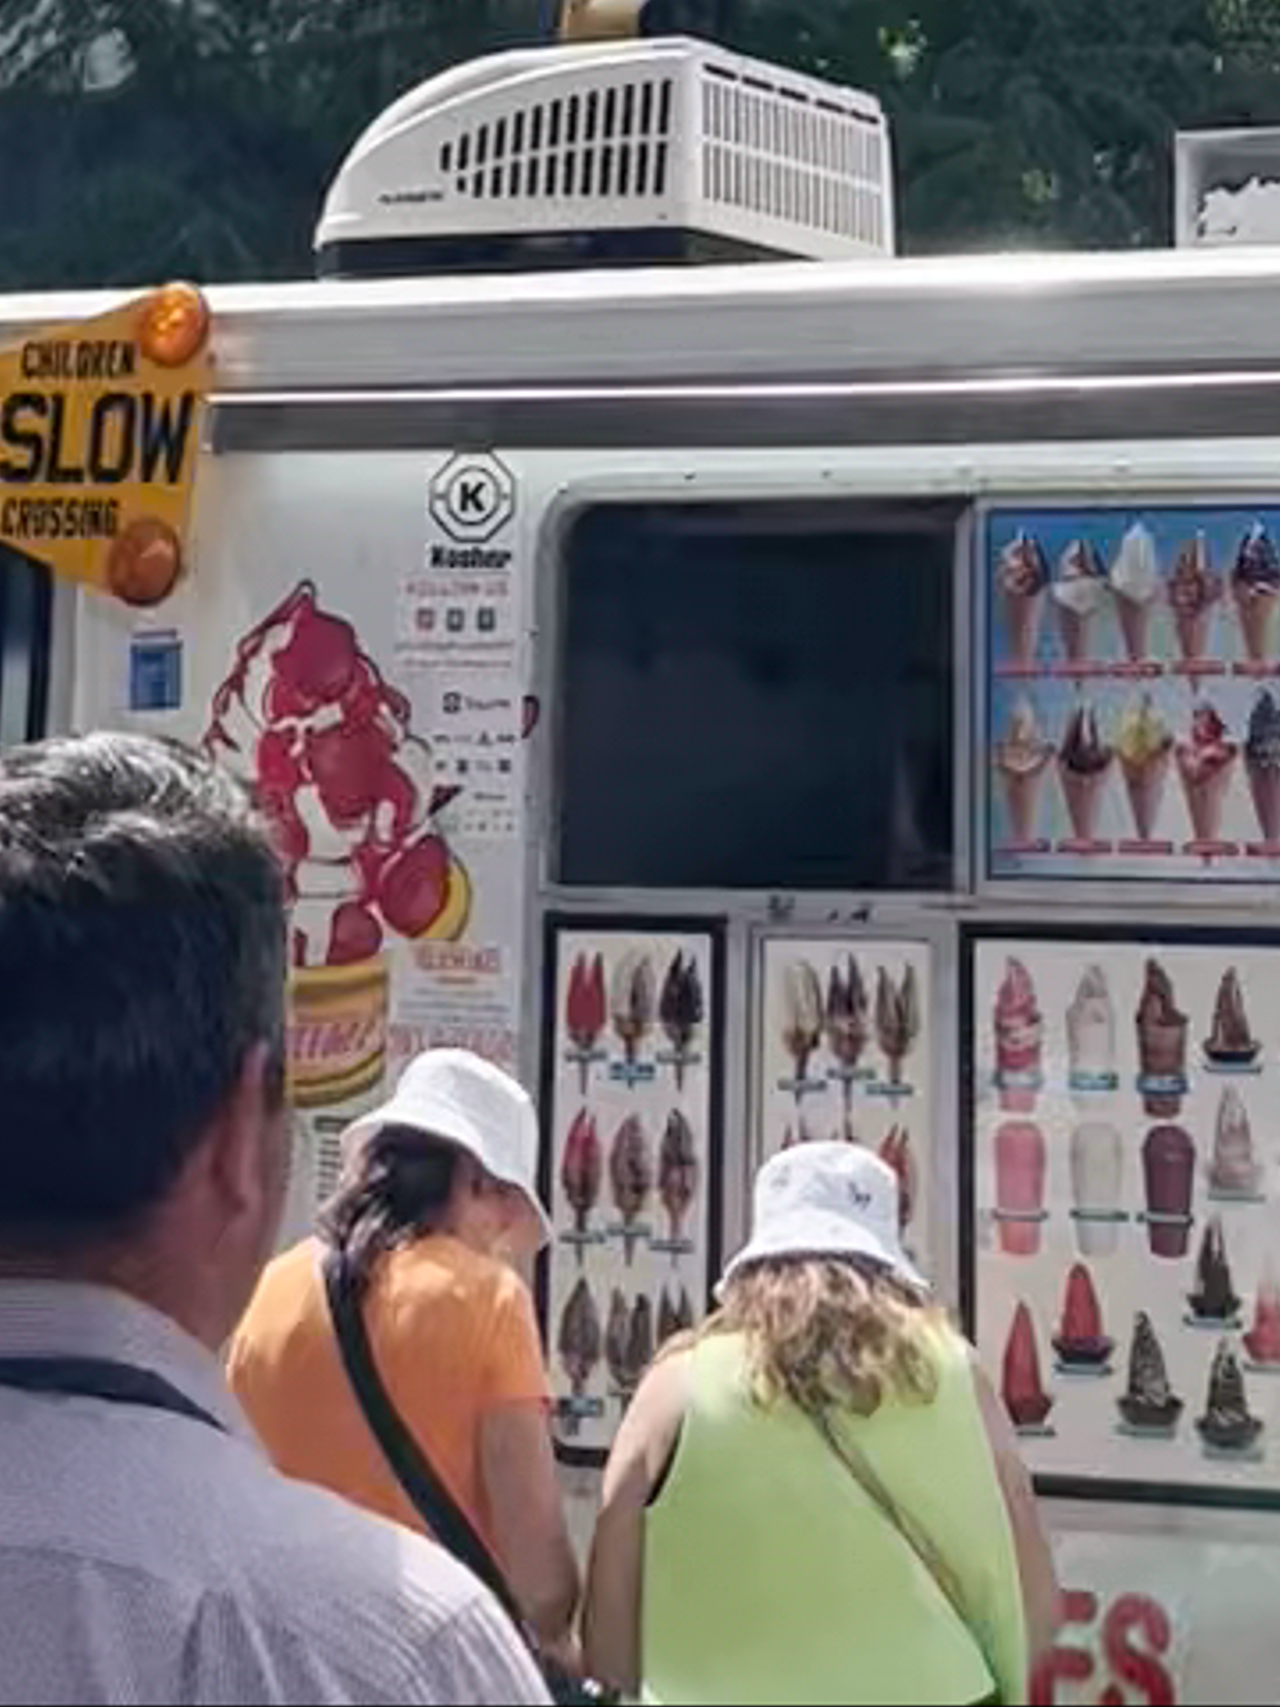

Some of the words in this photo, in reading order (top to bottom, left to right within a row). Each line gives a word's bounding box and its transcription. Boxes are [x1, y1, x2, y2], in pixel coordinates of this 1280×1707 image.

[22, 340, 135, 380] CHILDREN
[459, 481, 486, 512] K
[0, 496, 120, 539] CROSSING
[431, 544, 512, 569] Kosher
